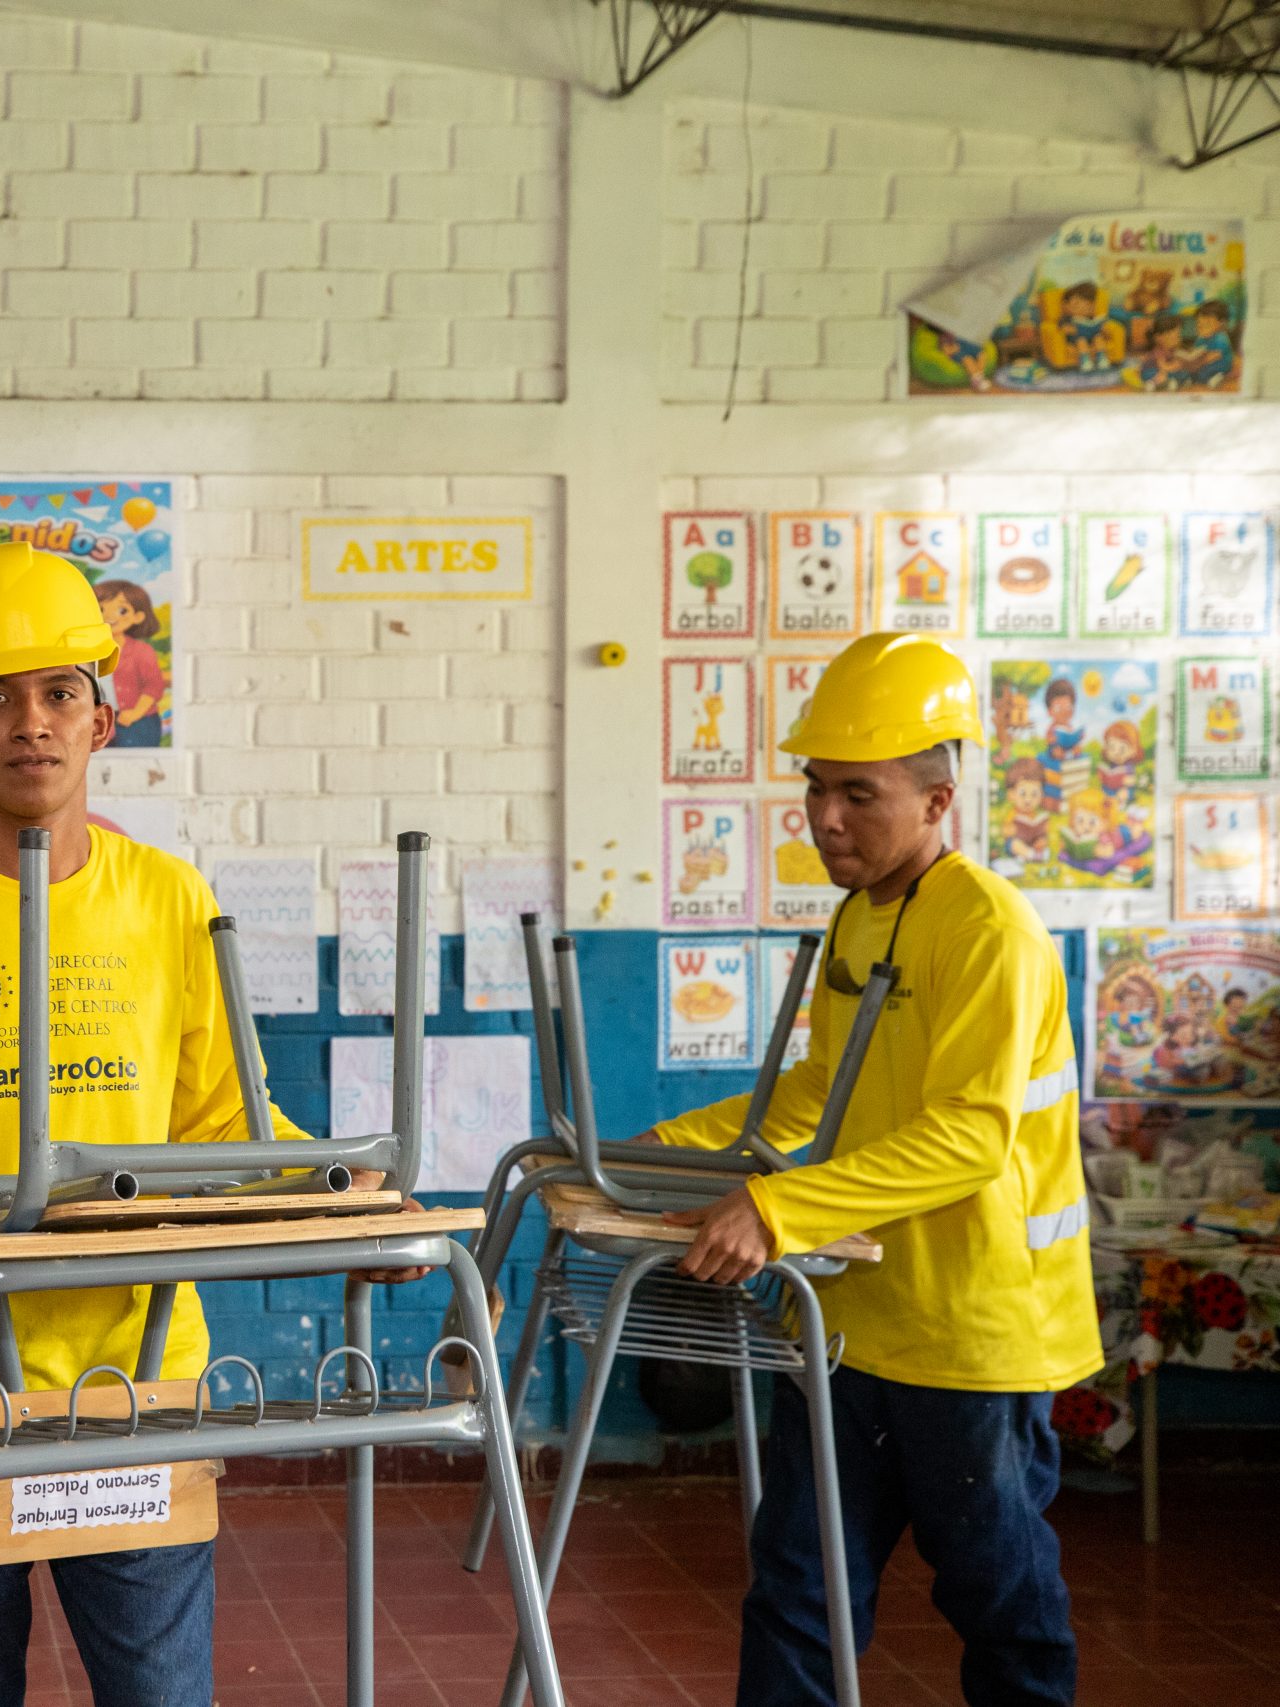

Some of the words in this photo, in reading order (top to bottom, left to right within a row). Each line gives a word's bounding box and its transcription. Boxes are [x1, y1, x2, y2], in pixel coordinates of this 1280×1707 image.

[1109, 220, 1206, 254] Lectura
[683, 522, 706, 547] A
[716, 528, 735, 546] a
[791, 523, 812, 547] B
[823, 523, 841, 546] b
[899, 522, 919, 546] C
[930, 531, 943, 546] c
[998, 523, 1019, 547] D
[1032, 524, 1050, 546] d
[1105, 523, 1120, 546] E
[1133, 529, 1148, 546] e
[1208, 522, 1224, 544] F
[336, 540, 498, 573] ARTES
[678, 605, 742, 630] árbol
[783, 606, 848, 630] balón
[893, 613, 950, 629] casa
[995, 608, 1054, 630] dona
[1097, 607, 1155, 630] elote
[788, 667, 809, 691] K
[1192, 667, 1218, 690] M
[1229, 672, 1256, 690] m
[675, 750, 743, 776] jirafa
[683, 810, 704, 833] P
[715, 816, 734, 839] p
[783, 809, 805, 838] Q
[671, 892, 746, 920] pastel
[774, 899, 832, 920] ques
[675, 951, 706, 976] W
[715, 958, 740, 975] w
[71, 1000, 137, 1014] CENTROS
[10, 1026, 20, 1036] D
[87, 1083, 95, 1092] la
[98, 1082, 140, 1091] sociedad
[24, 1479, 89, 1498] Palacios
[96, 1473, 161, 1489] Serrano
[17, 1507, 78, 1526] Enrique
[85, 1500, 167, 1518] Jefferson
